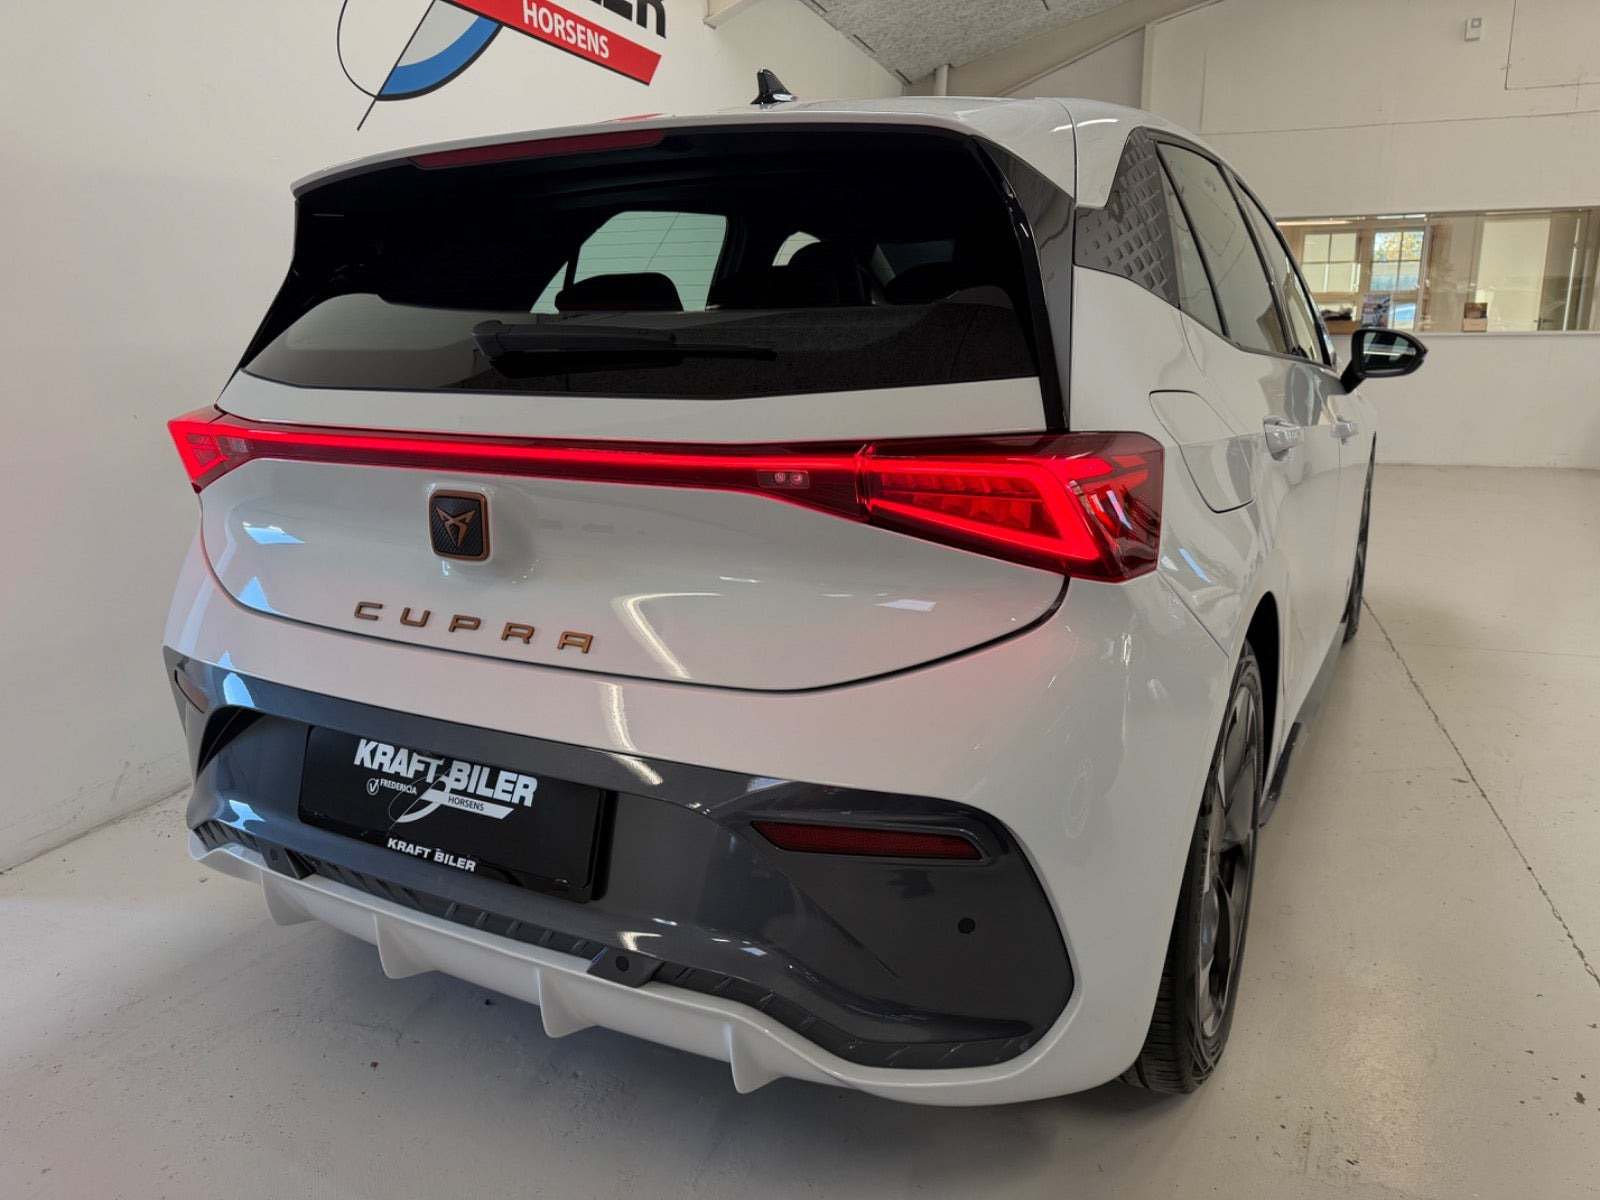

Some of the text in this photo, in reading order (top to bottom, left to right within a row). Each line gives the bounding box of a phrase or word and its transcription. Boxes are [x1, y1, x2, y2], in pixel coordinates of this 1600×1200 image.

[522, 0, 609, 59] HORSENS
[353, 600, 594, 654] CUPRA
[353, 738, 538, 808] KRAFT BILER
[380, 778, 417, 795] FREDERICIA
[448, 795, 484, 811] HORSENS
[387, 837, 476, 872] KRAFT BILER
